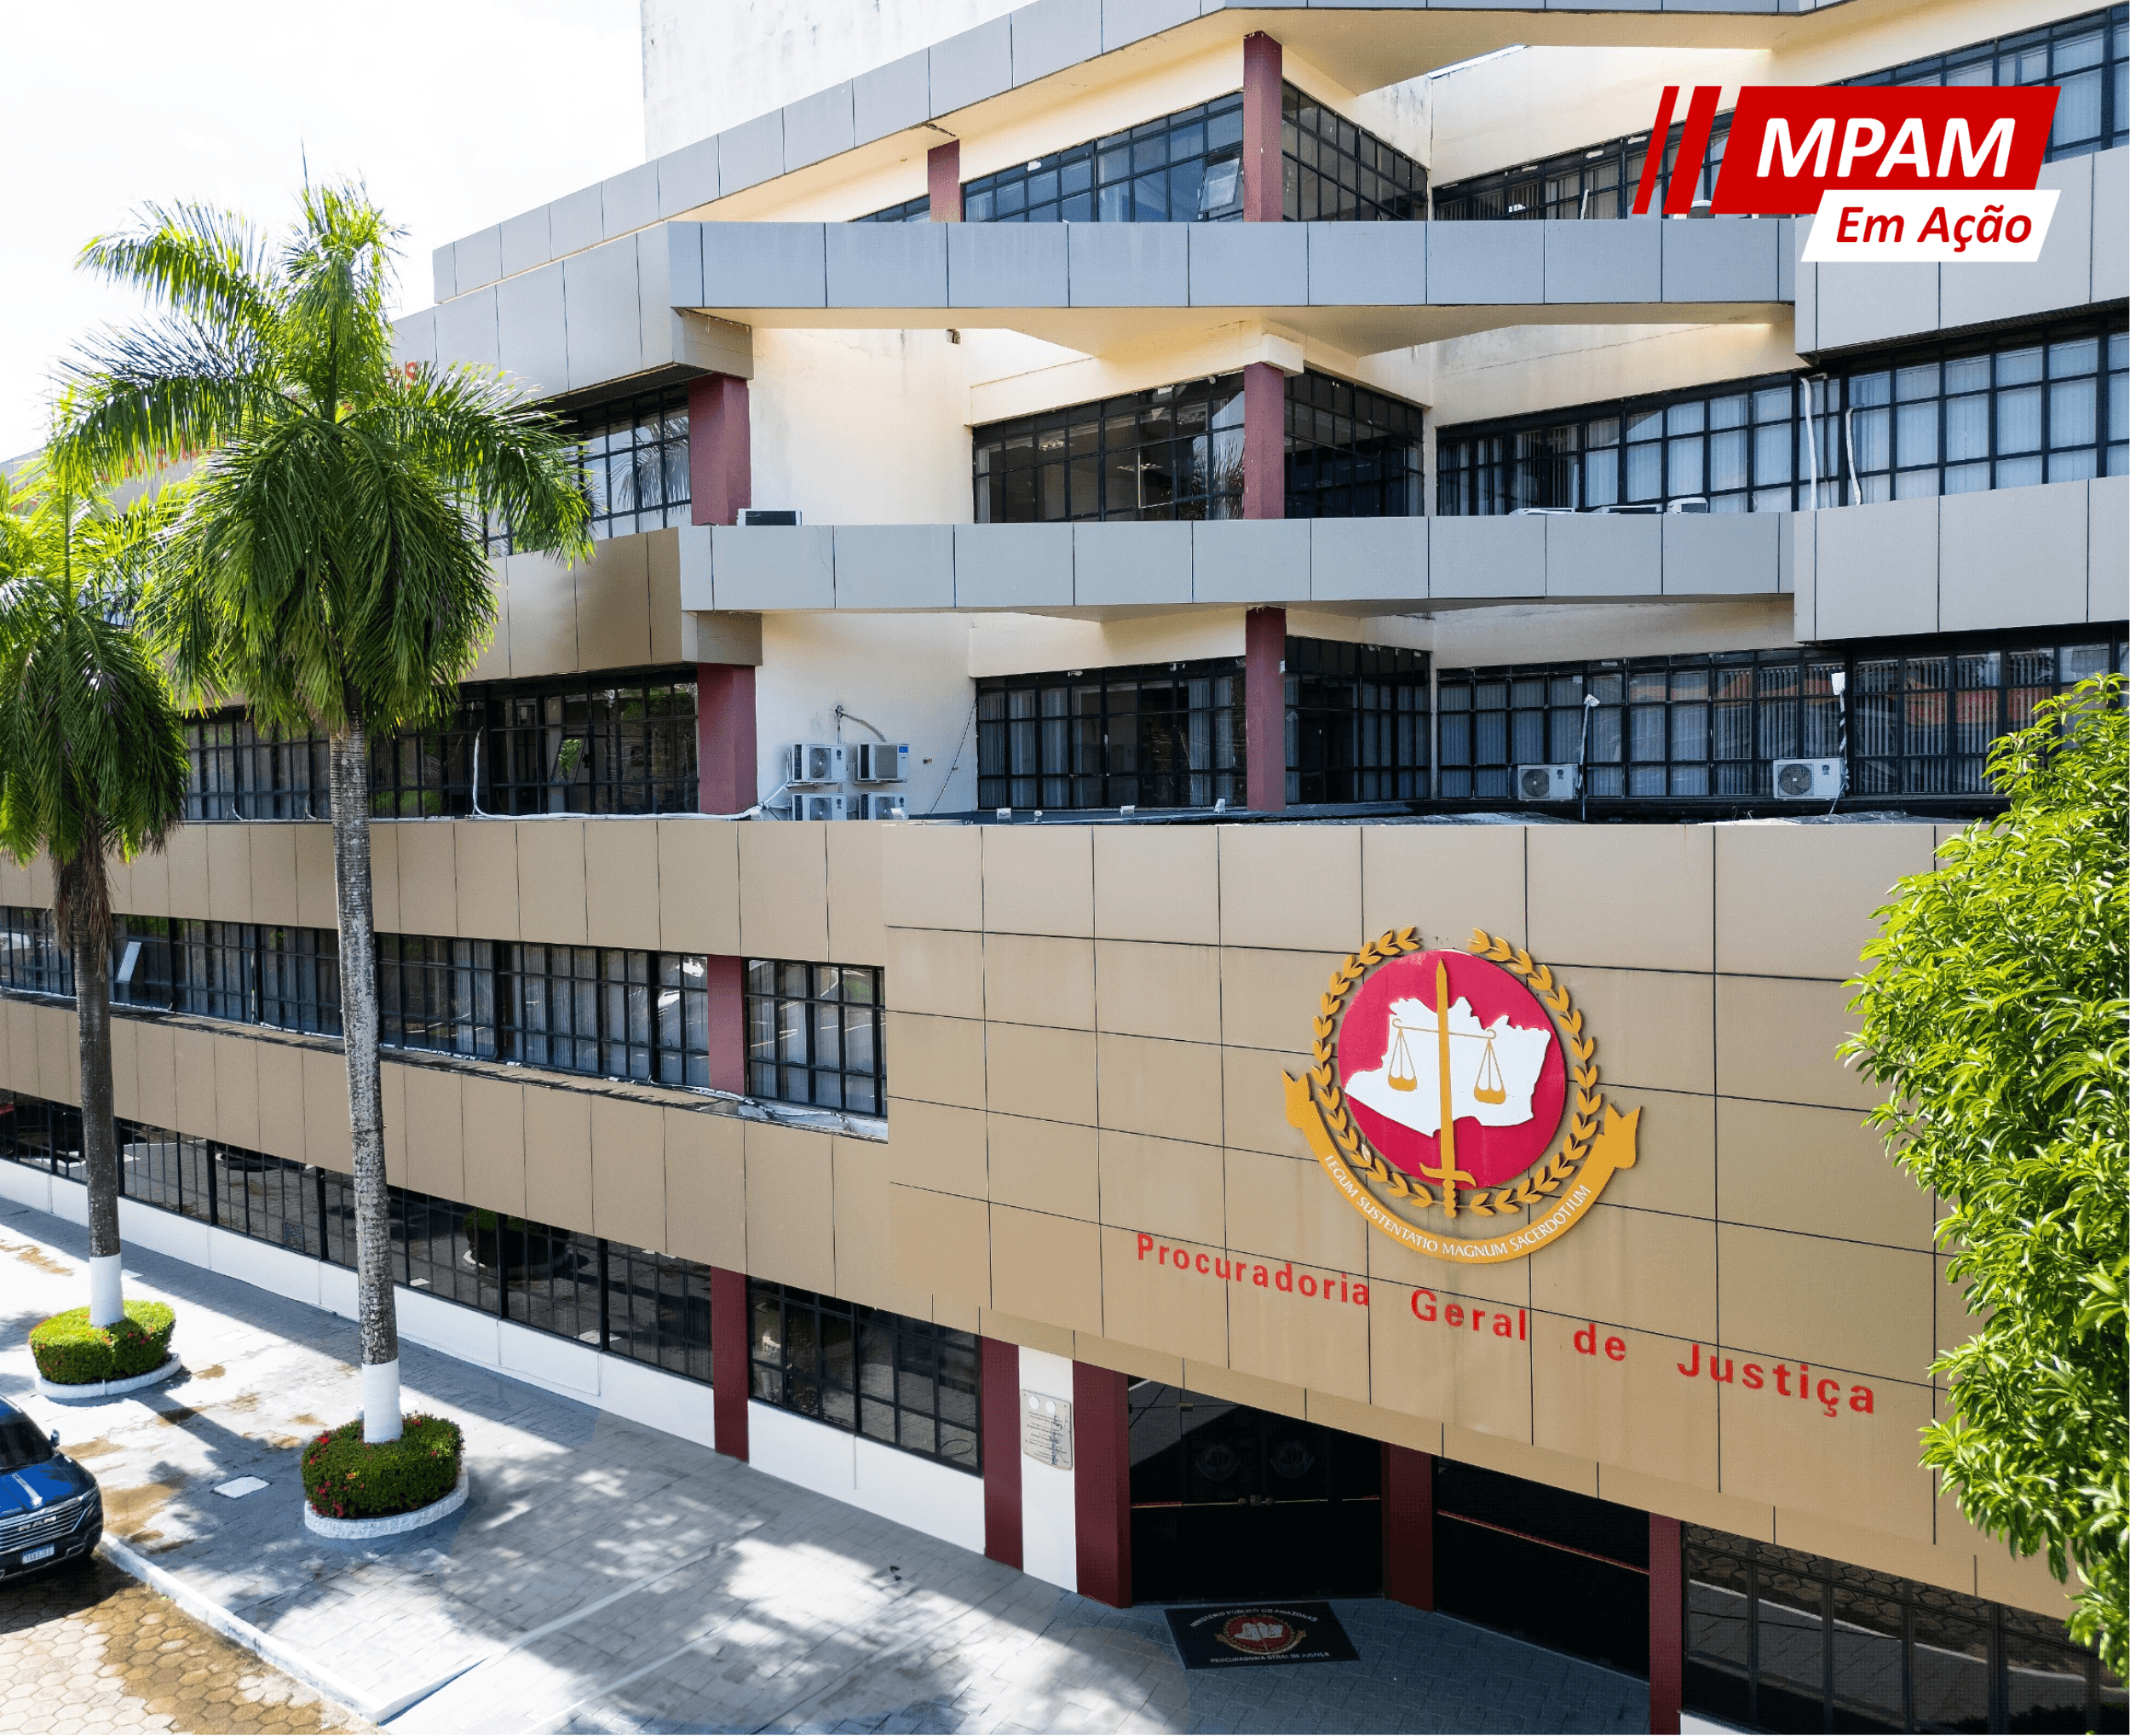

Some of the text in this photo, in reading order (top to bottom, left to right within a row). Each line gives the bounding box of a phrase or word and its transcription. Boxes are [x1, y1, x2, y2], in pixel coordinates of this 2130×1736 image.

[1324, 1155, 1592, 1257] LEGUM SUSTENTATIO MAGNUM SACERDOTIUM
[1137, 1233, 1874, 1418] Procuradoria Geral de Justiça
